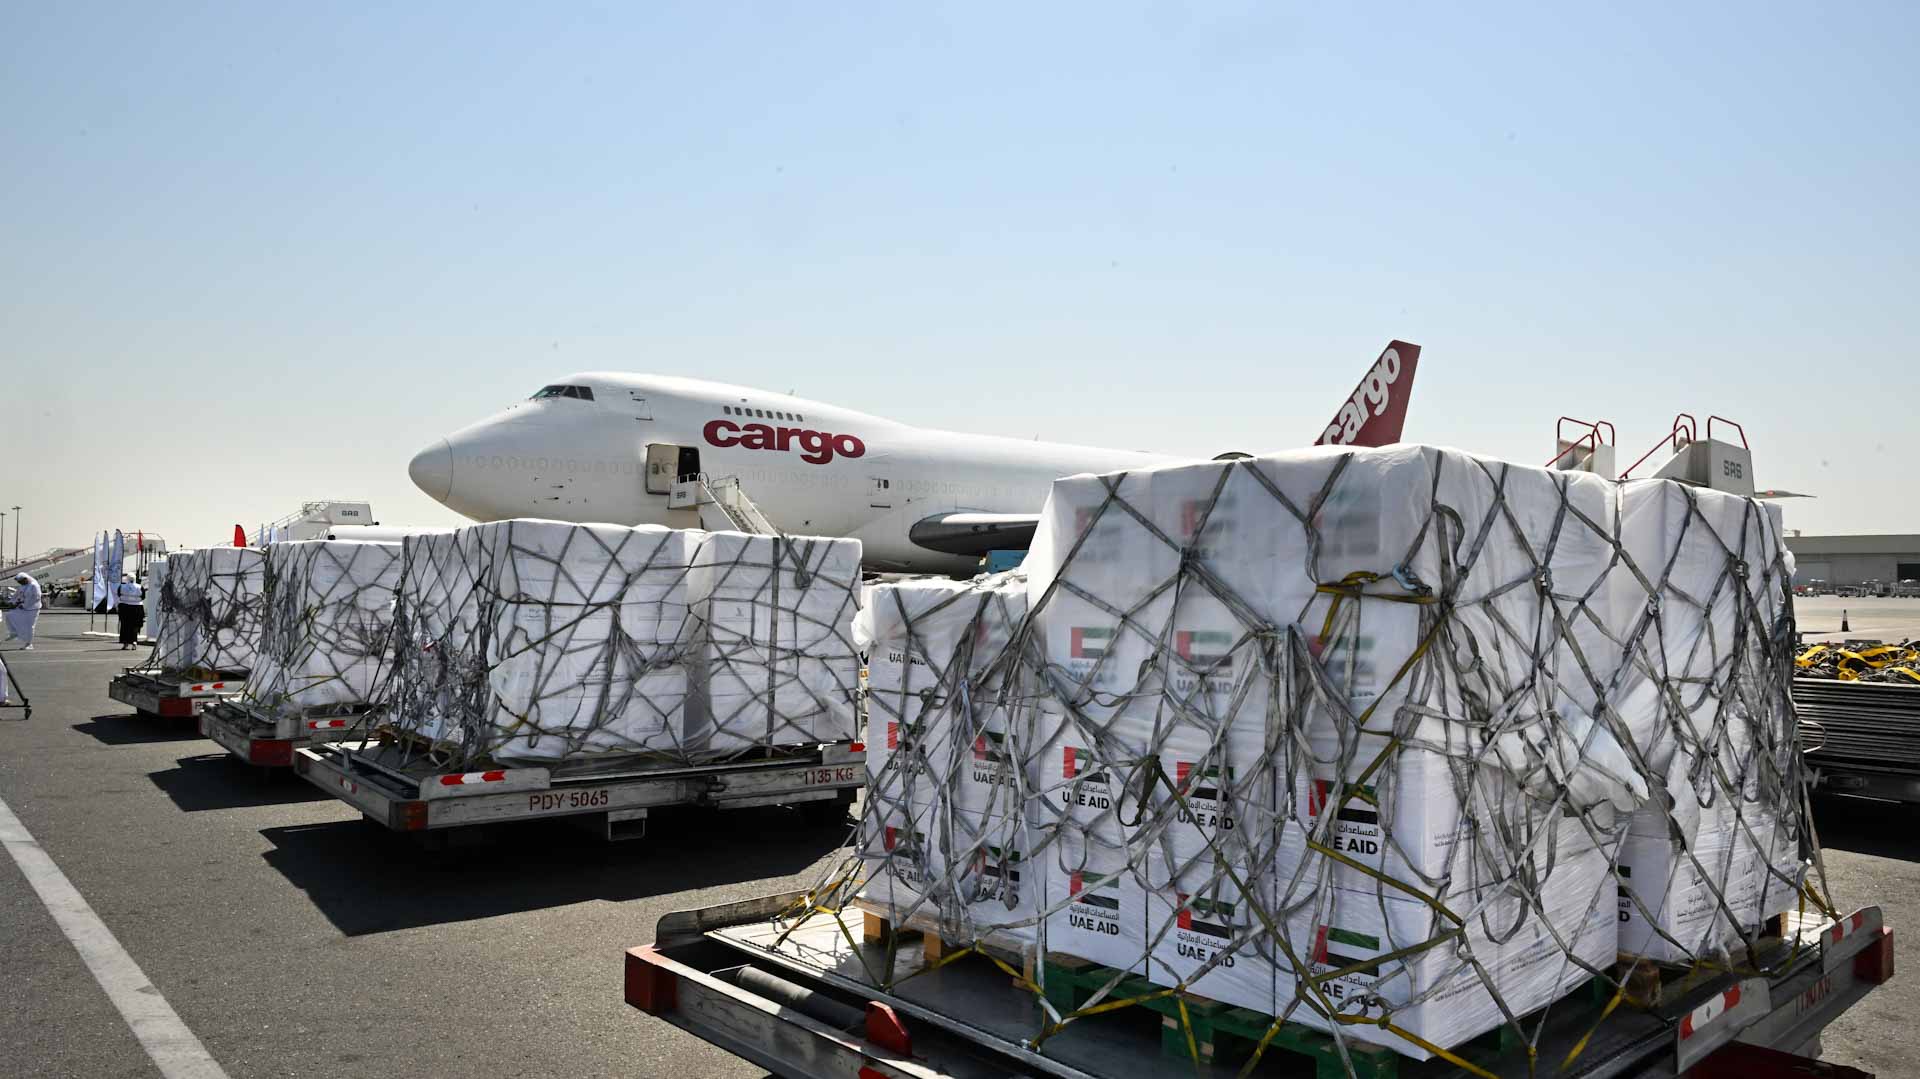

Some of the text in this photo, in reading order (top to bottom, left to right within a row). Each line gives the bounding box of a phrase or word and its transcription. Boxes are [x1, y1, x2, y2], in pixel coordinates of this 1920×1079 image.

[1322, 348, 1401, 445] cargo
[703, 420, 866, 465] cargo
[804, 767, 853, 785] 1135 KG
[529, 789, 609, 811] PDY 5065
[1062, 791, 1110, 810] UE AID
[1177, 808, 1206, 827] UE
[1346, 838, 1378, 855] AID
[1069, 914, 1120, 936] UAE AID
[1177, 942, 1206, 961] UAE
[1318, 981, 1344, 1000] AE
